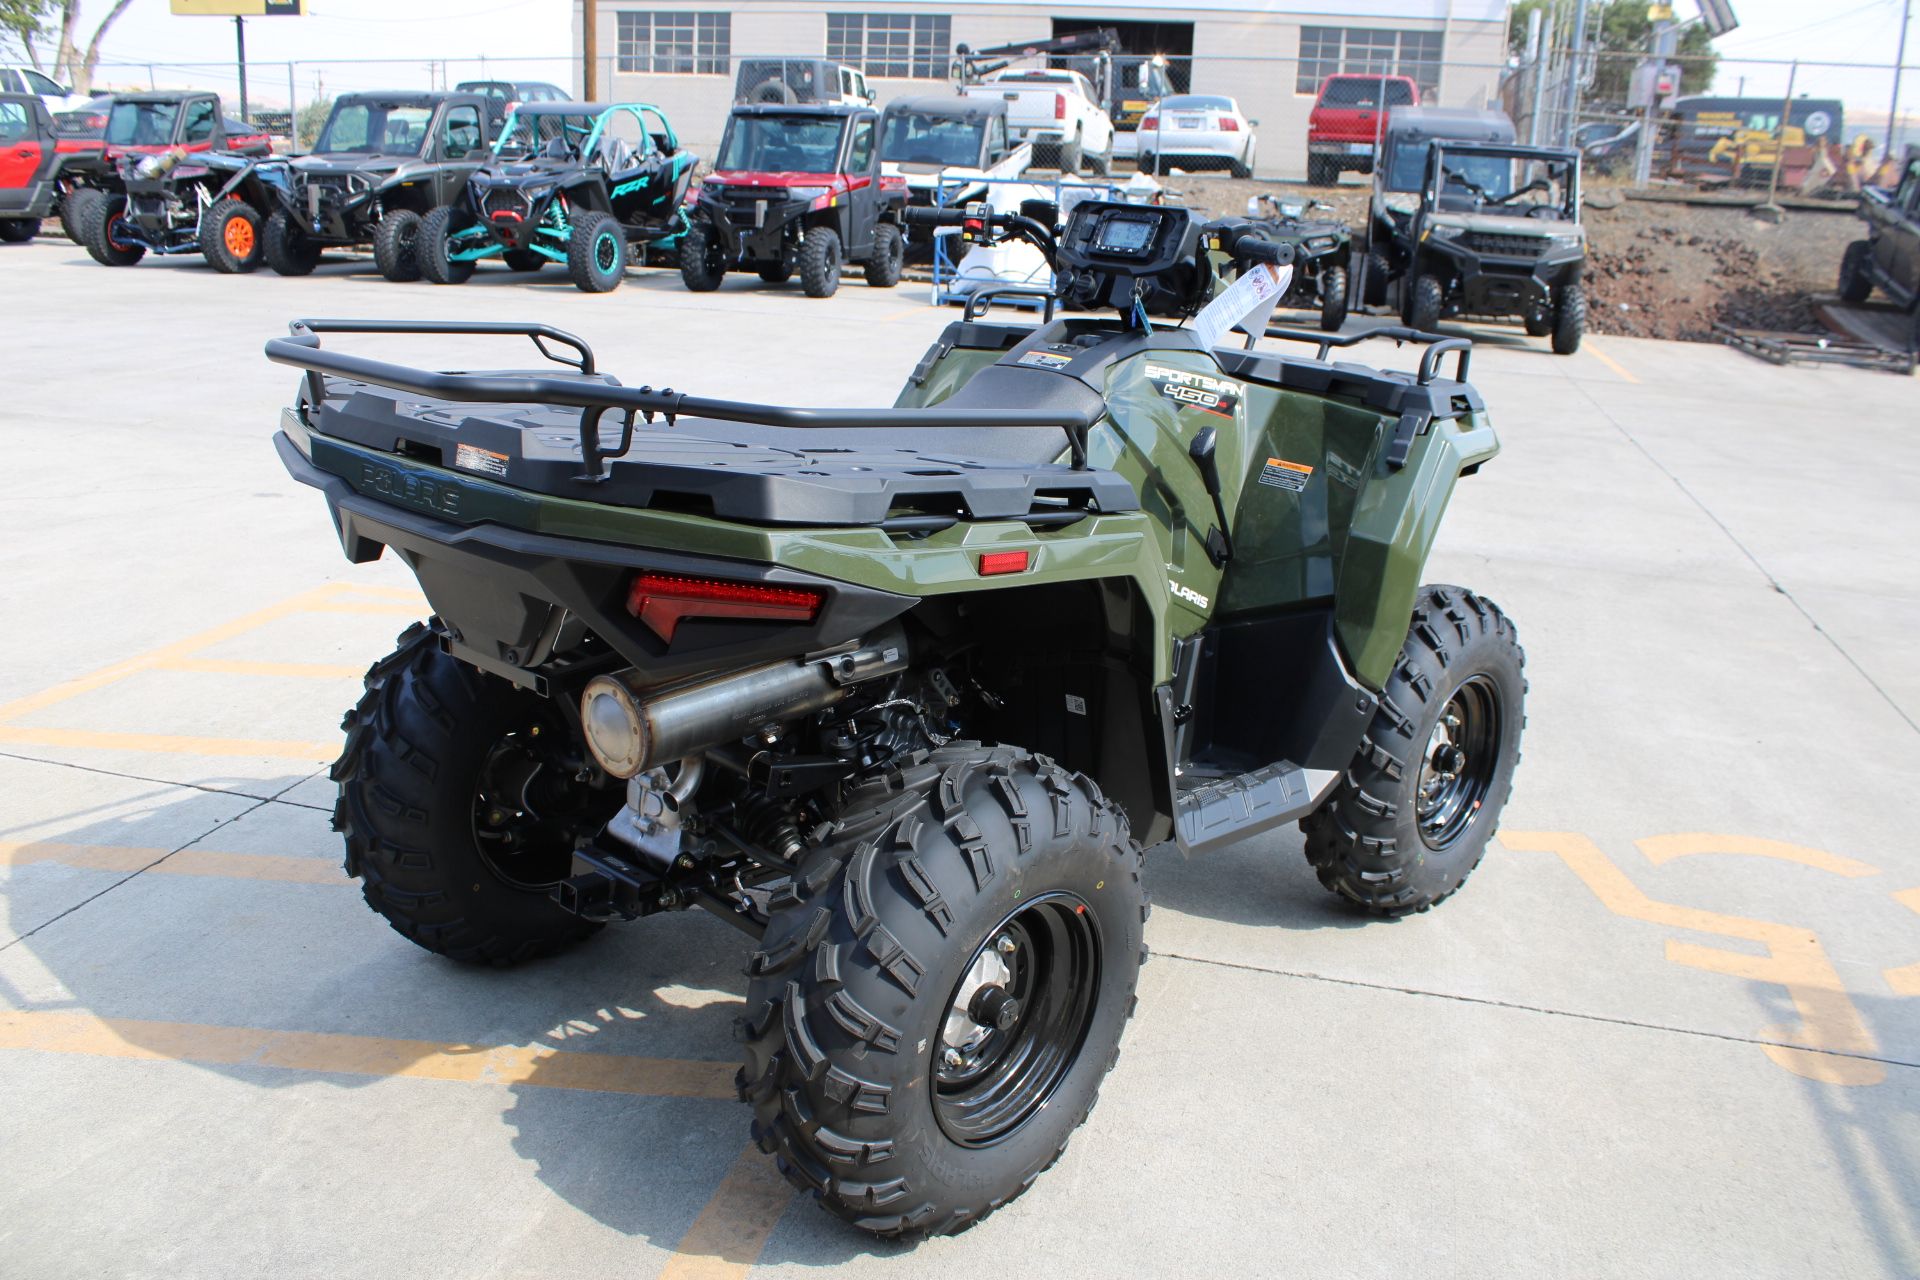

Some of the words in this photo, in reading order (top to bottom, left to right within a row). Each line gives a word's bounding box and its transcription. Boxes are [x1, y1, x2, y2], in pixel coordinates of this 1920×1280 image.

[610, 175, 650, 200] RZR
[1144, 364, 1245, 397] SPORTSMAN
[1163, 383, 1220, 408] 450
